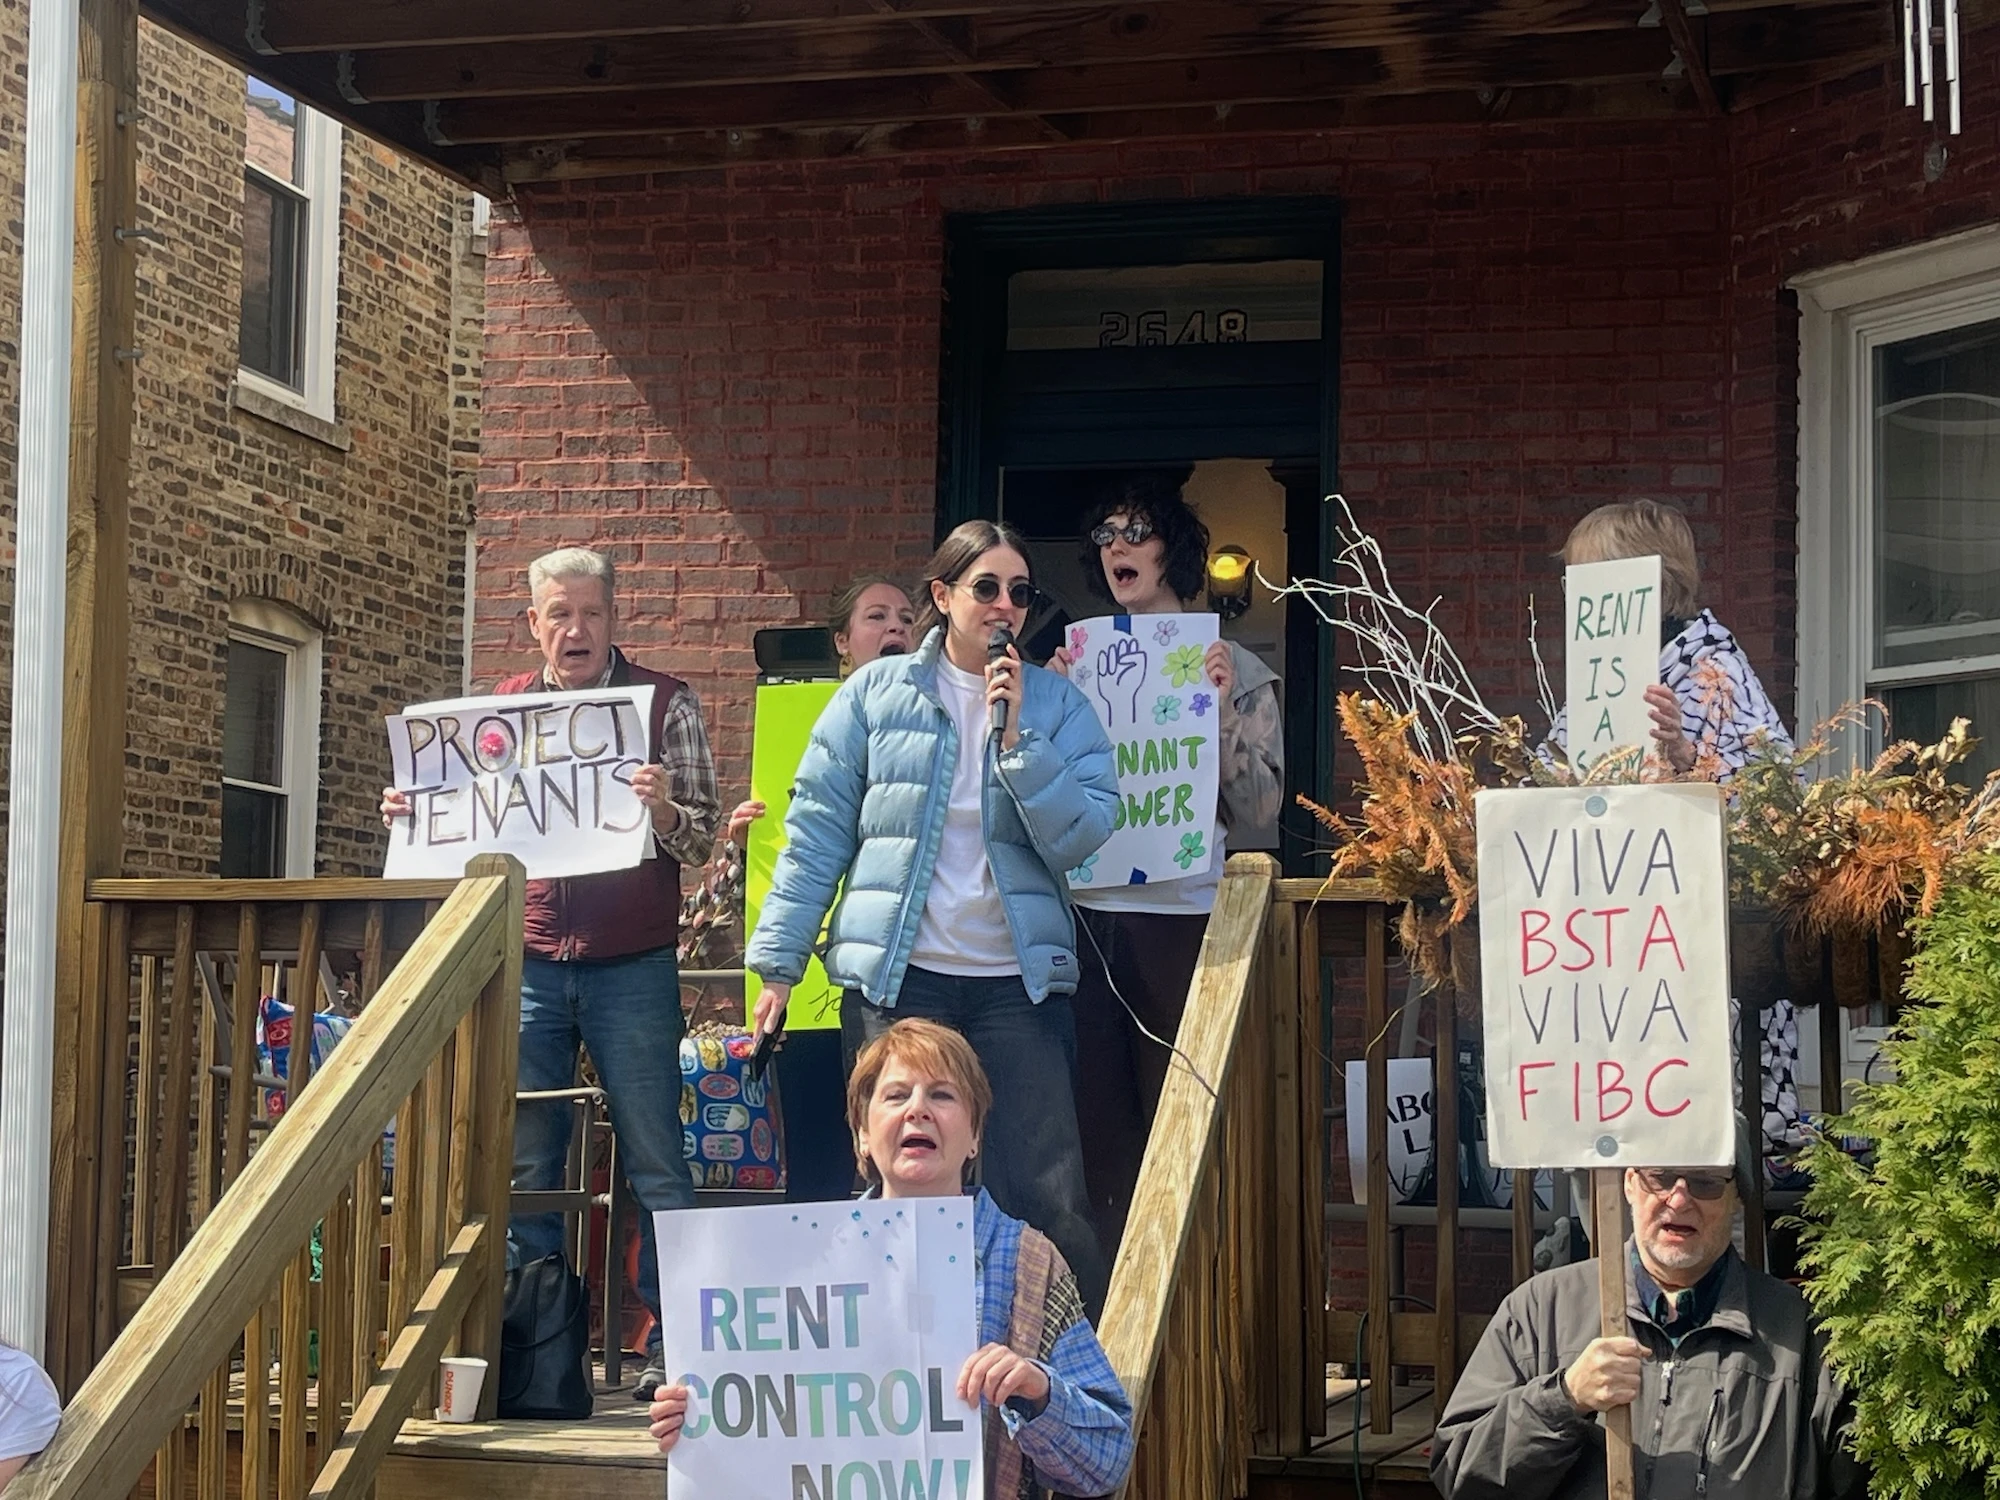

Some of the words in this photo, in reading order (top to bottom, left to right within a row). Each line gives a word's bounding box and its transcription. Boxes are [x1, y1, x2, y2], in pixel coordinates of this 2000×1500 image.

[1575, 587, 1653, 641] RENT
[1585, 656, 1627, 702] IS
[405, 697, 634, 785] PROTECT
[1115, 736, 1207, 778] NANT
[1593, 707, 1615, 742] A
[401, 757, 645, 847] TENANTS
[1514, 828, 1680, 898] VIVA
[1520, 905, 1685, 976] BSTA
[1519, 978, 1688, 1045] VIVA
[1519, 1058, 1691, 1123] FIBC
[700, 1283, 869, 1351] RENT
[676, 1368, 964, 1439] CONTROL
